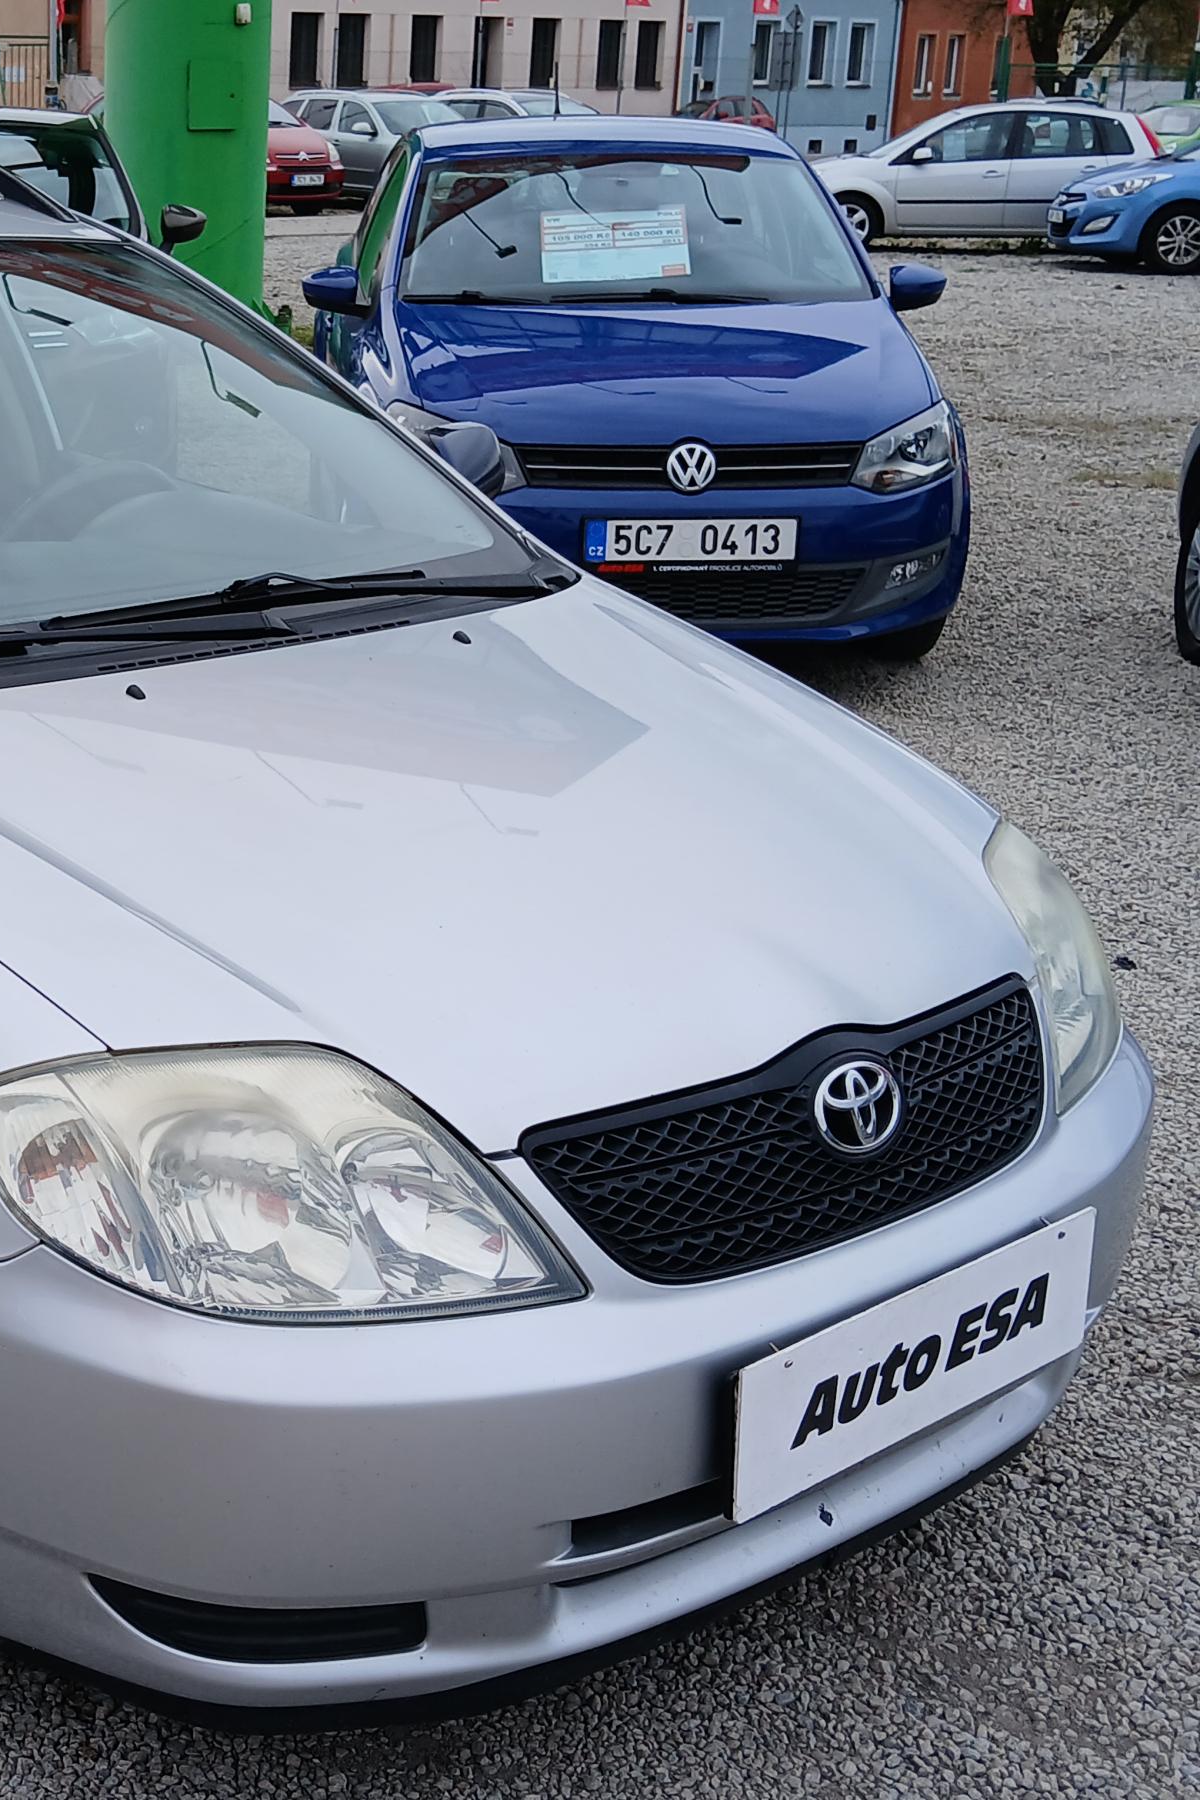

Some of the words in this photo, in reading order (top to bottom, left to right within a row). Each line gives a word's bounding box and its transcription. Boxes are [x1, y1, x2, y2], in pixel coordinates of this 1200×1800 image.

[613, 524, 674, 556] 5C7
[700, 524, 781, 556] 0413
[588, 546, 604, 556] CZ
